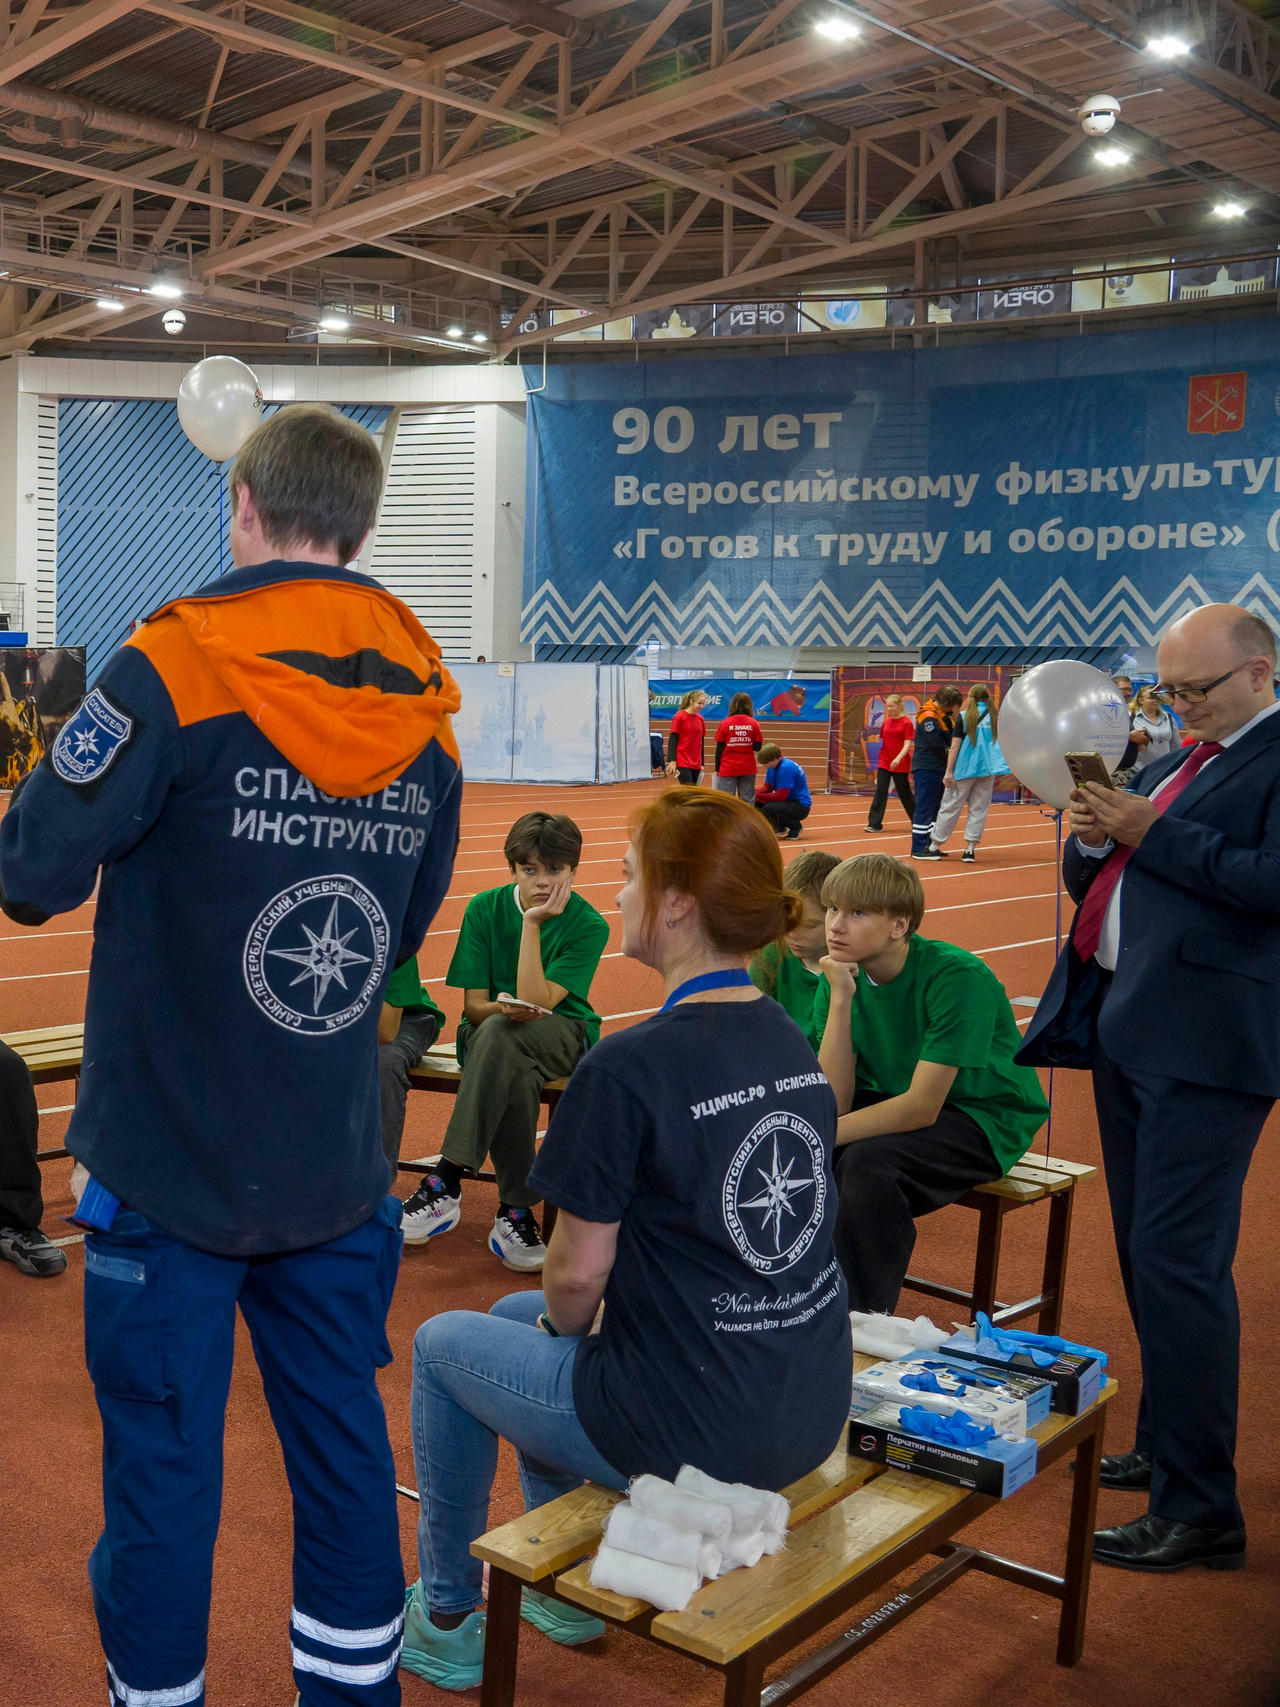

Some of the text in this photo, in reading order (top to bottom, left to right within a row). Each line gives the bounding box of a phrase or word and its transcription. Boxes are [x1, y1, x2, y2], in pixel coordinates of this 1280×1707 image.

[612, 405, 842, 454] 90 лет
[614, 468, 980, 514] Всероссийскому
[613, 528, 760, 560] «Готов
[774, 534, 800, 558] к
[814, 530, 949, 566] труду
[964, 530, 991, 555] и
[1008, 516, 1247, 561] обороне»
[88, 698, 124, 734] СПАСАТЕЛЬ
[234, 766, 432, 816] СПАЕЛЬ
[231, 807, 426, 858] ИНСТРУКТОР
[248, 894, 303, 1027] САНКТ-ПЕТЕРБУРГСКИЙ
[690, 1072, 828, 1120] УЦМЧС.РФ UCMCHS.RU
[725, 1142, 772, 1271] САНКТ-ПЕТЕРБУРГСКИЙ
[751, 1115, 788, 1144] УЧЕБНЫЙ
[790, 1119, 818, 1147] ЦЕНТР
[714, 1320, 752, 1332] Учимся
[753, 1321, 763, 1331] не
[763, 1318, 779, 1330] для
[814, 1287, 838, 1311] жизни
[852, 1386, 864, 1395] oxy
[887, 1433, 926, 1451] Перчатки
[926, 1445, 979, 1467] нитриловые
